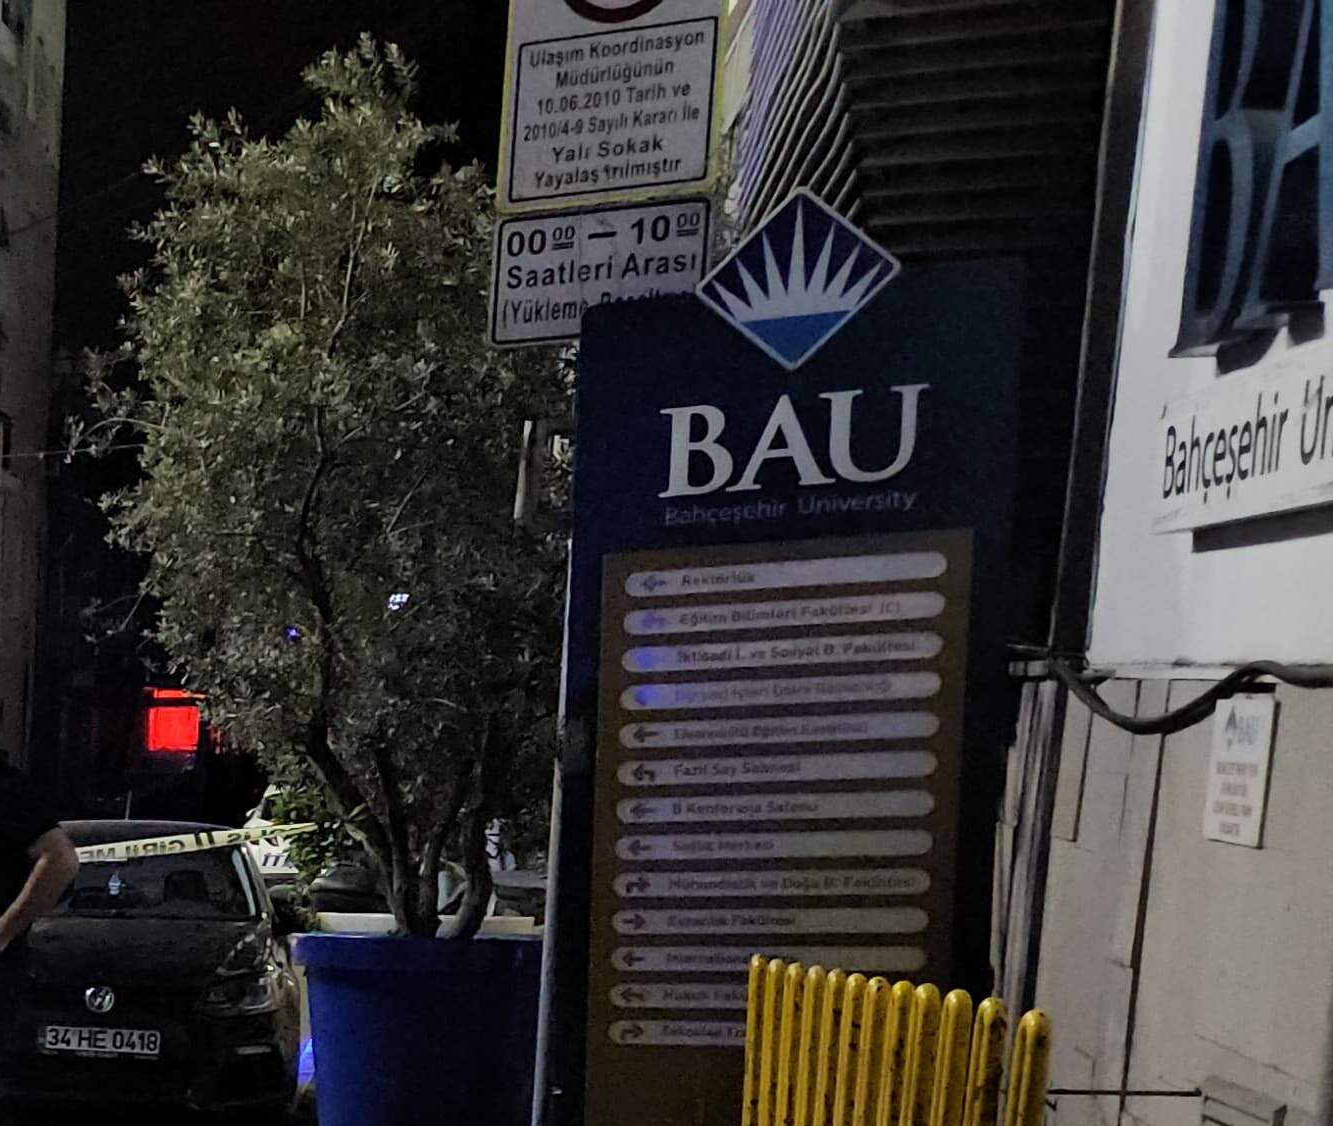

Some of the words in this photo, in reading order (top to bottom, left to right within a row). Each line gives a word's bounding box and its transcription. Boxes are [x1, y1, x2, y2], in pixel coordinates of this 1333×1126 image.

[529, 46, 584, 68] Ulaşım
[589, 30, 705, 60] Koordinasyon
[555, 60, 675, 89] Müdürlüğünün
[537, 89, 621, 115] 10.06.2010
[626, 84, 666, 104] Tarih
[671, 83, 691, 97] ve
[588, 113, 628, 135] Sayılı
[633, 109, 678, 127] Kararı
[552, 144, 589, 164] Yalı
[597, 135, 664, 158] Sokak
[506, 258, 613, 289] Saatleri
[620, 250, 697, 279] Arası
[658, 384, 930, 498] BAU
[1163, 391, 1289, 504] Bahçeşehir
[664, 501, 787, 526] Bahçeşehir
[798, 491, 918, 514] University
[48, 1028, 71, 1048] 34
[77, 1029, 108, 1050] HE
[112, 1030, 159, 1053] 0418
